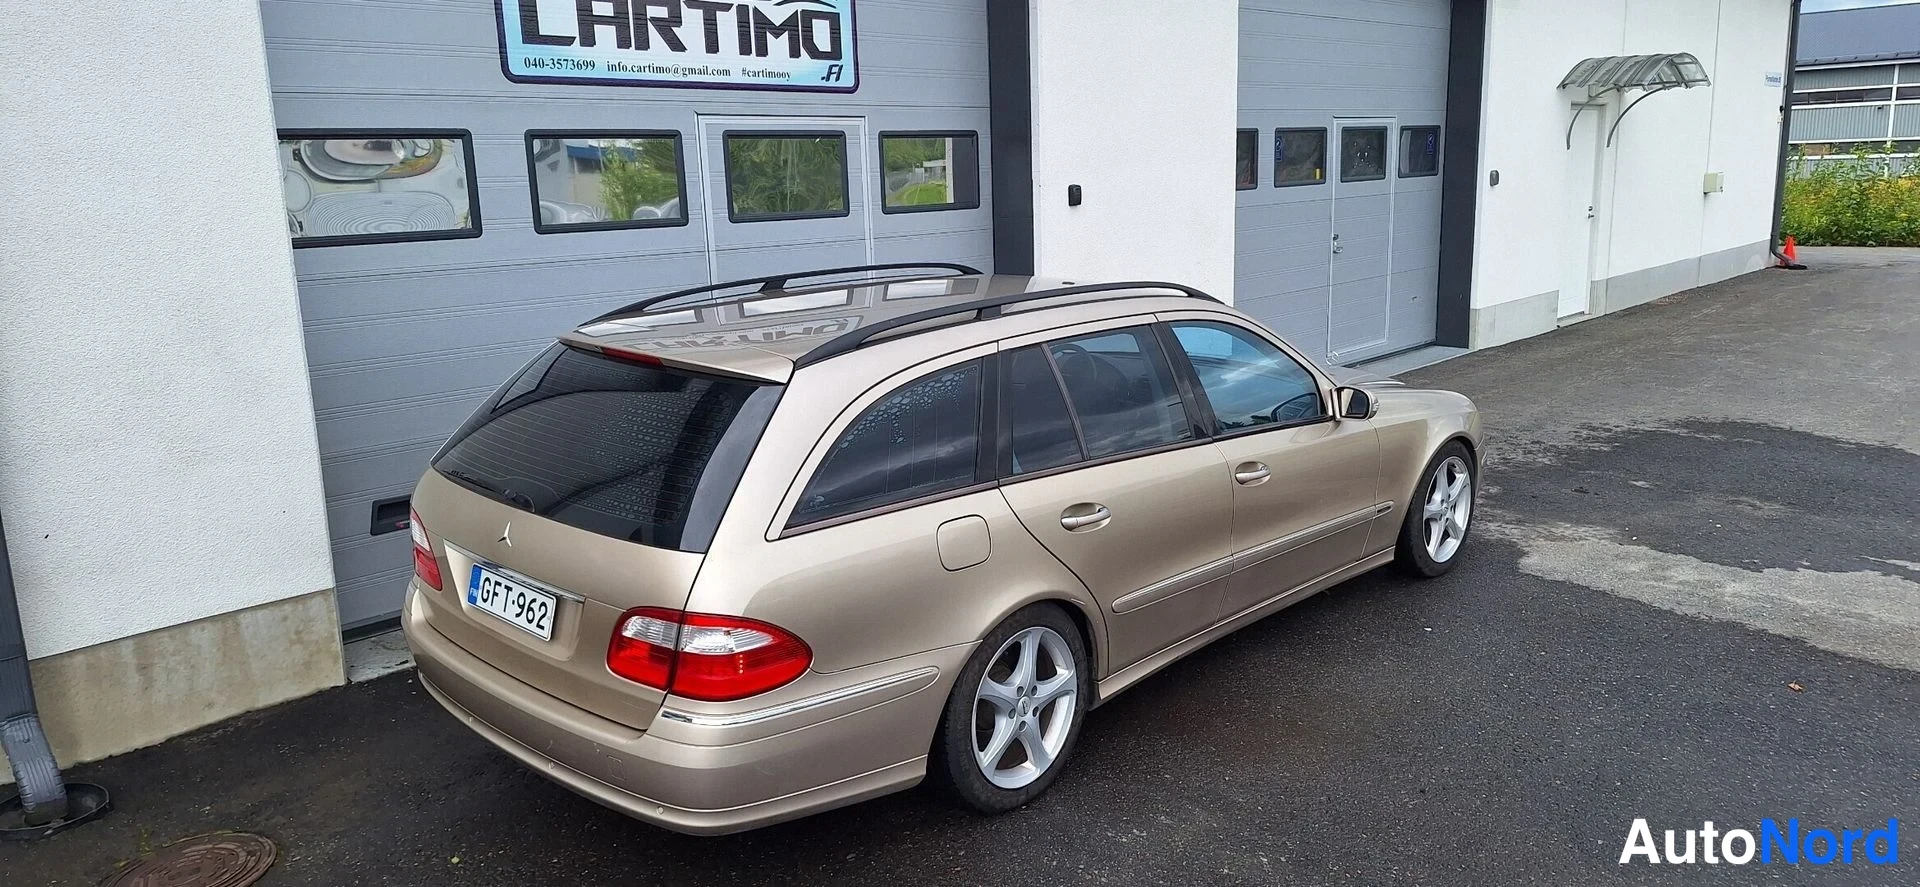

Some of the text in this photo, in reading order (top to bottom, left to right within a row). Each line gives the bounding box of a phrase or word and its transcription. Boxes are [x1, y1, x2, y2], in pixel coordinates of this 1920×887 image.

[519, 0, 844, 61] CARTIMO
[523, 57, 792, 82] 040-3573699 info.cartimo@gmail.com #cartimooy
